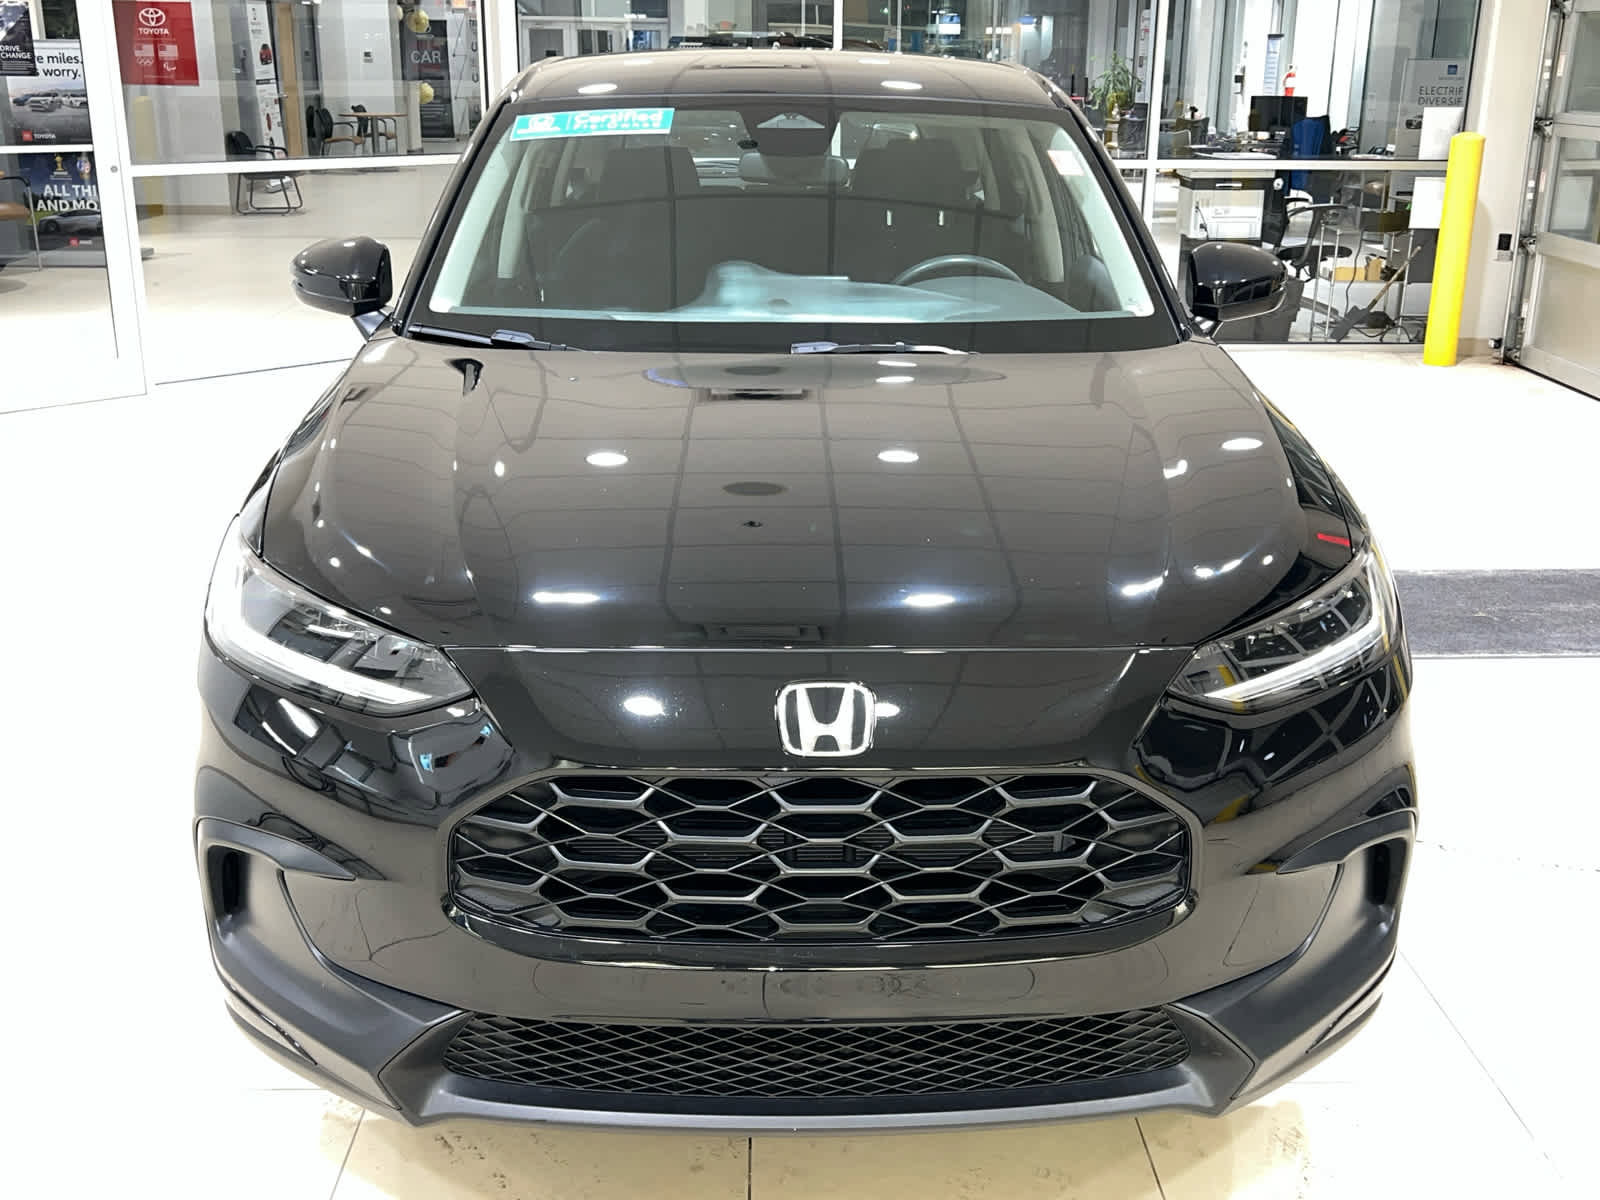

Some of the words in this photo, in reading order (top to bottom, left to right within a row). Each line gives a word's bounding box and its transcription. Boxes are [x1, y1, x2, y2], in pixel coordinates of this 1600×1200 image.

[410, 50, 440, 64] CAR
[42, 68, 81, 80] worry.
[574, 110, 663, 125] Certified
[43, 184, 70, 197] ALL
[72, 184, 97, 197] THI
[37, 199, 70, 212] AND
[72, 200, 98, 211] MO
